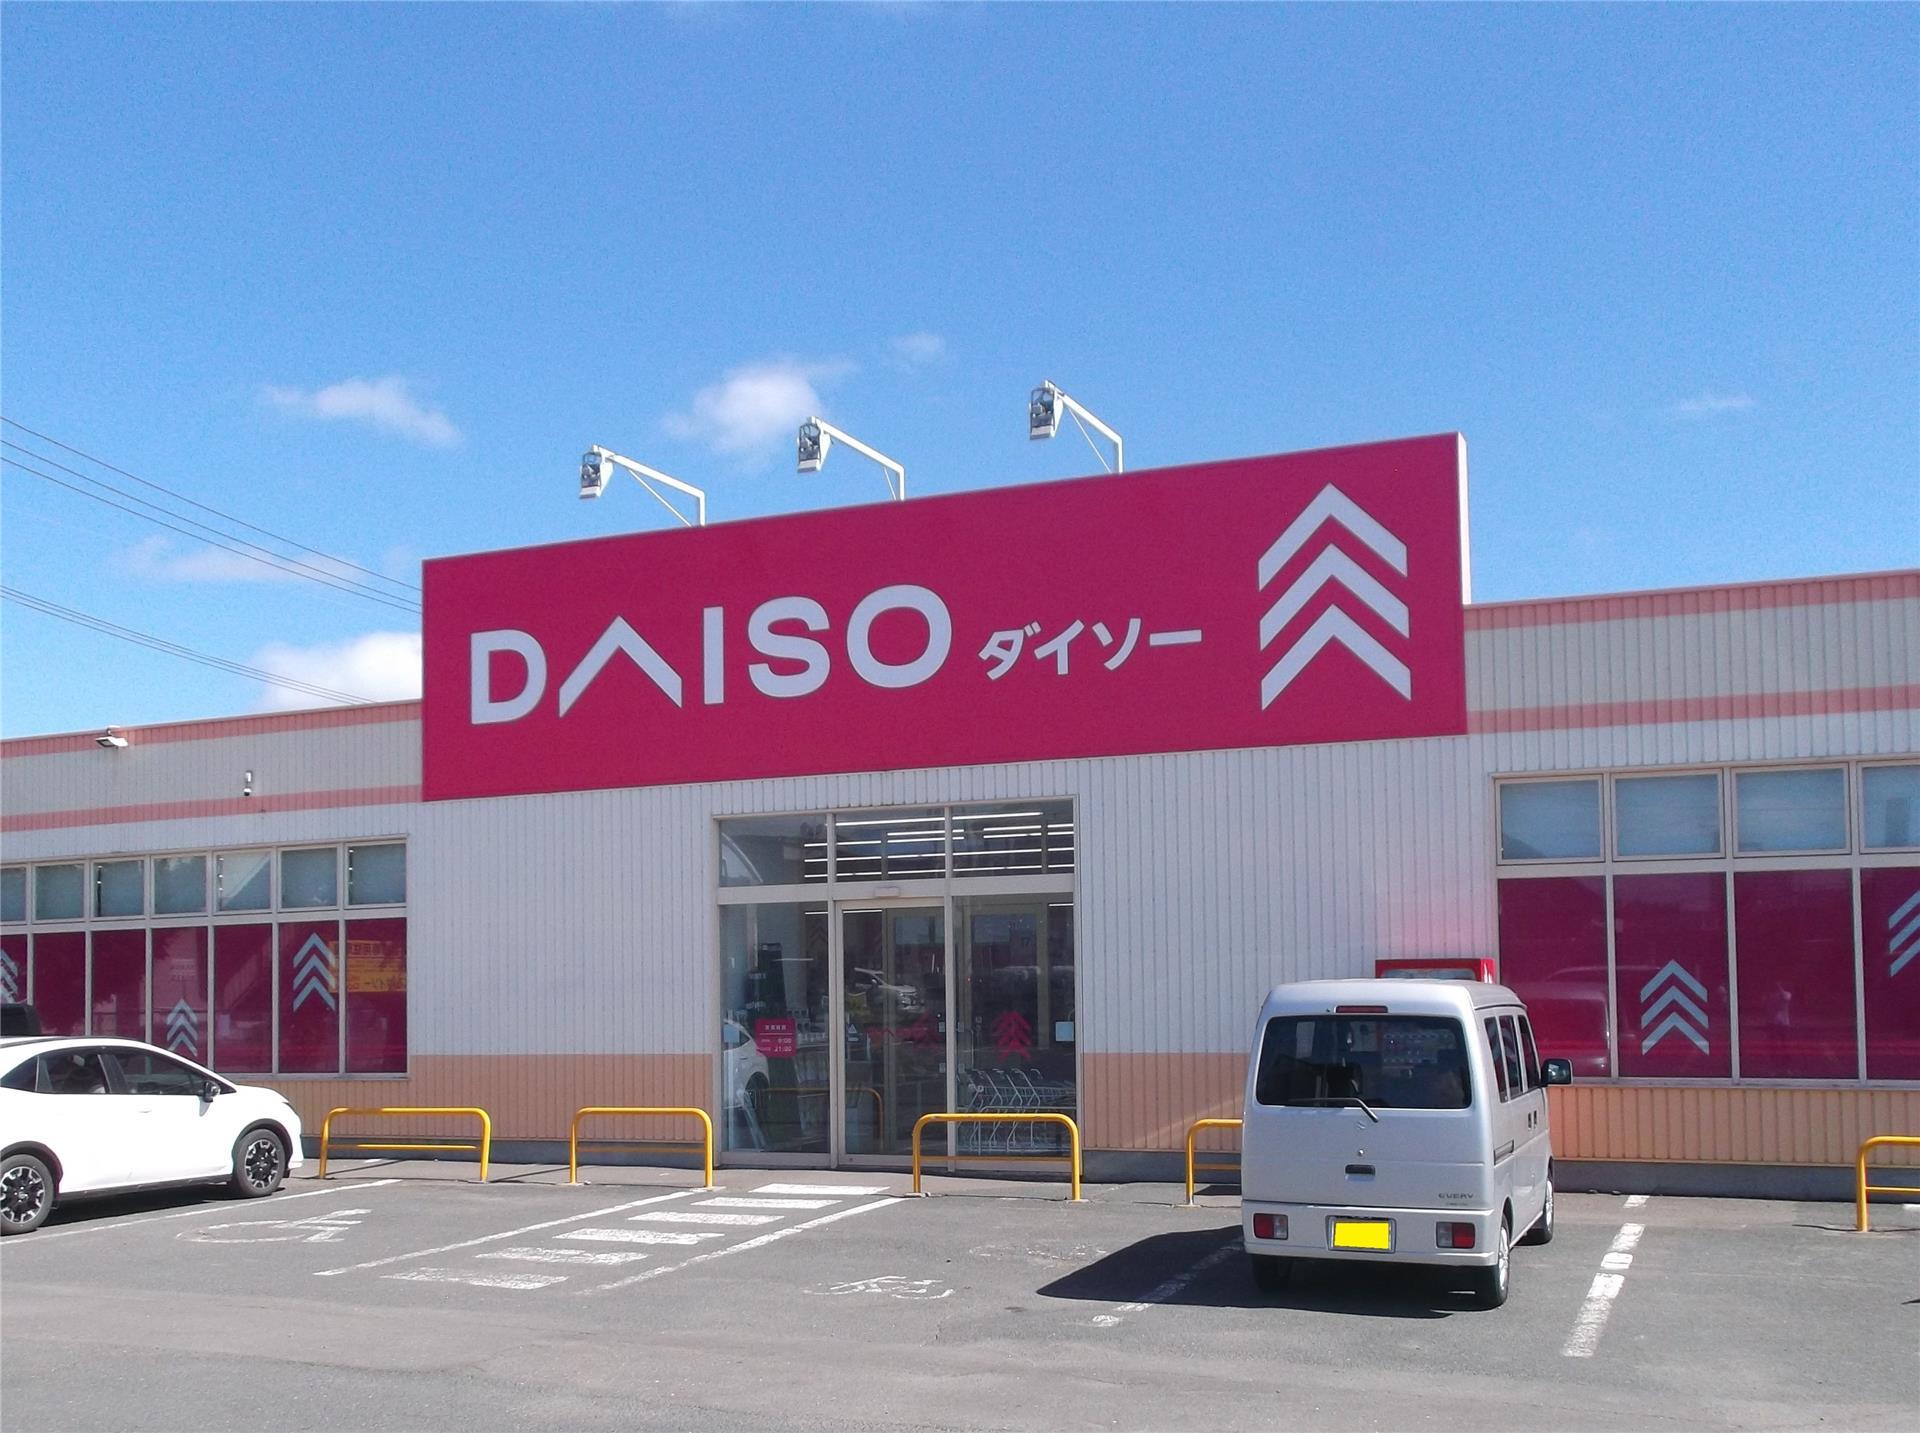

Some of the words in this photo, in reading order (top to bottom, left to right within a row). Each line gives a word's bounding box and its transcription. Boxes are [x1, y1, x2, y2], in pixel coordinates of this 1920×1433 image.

[470, 584, 952, 725] DAISO
[978, 617, 1202, 681] ダイソー
